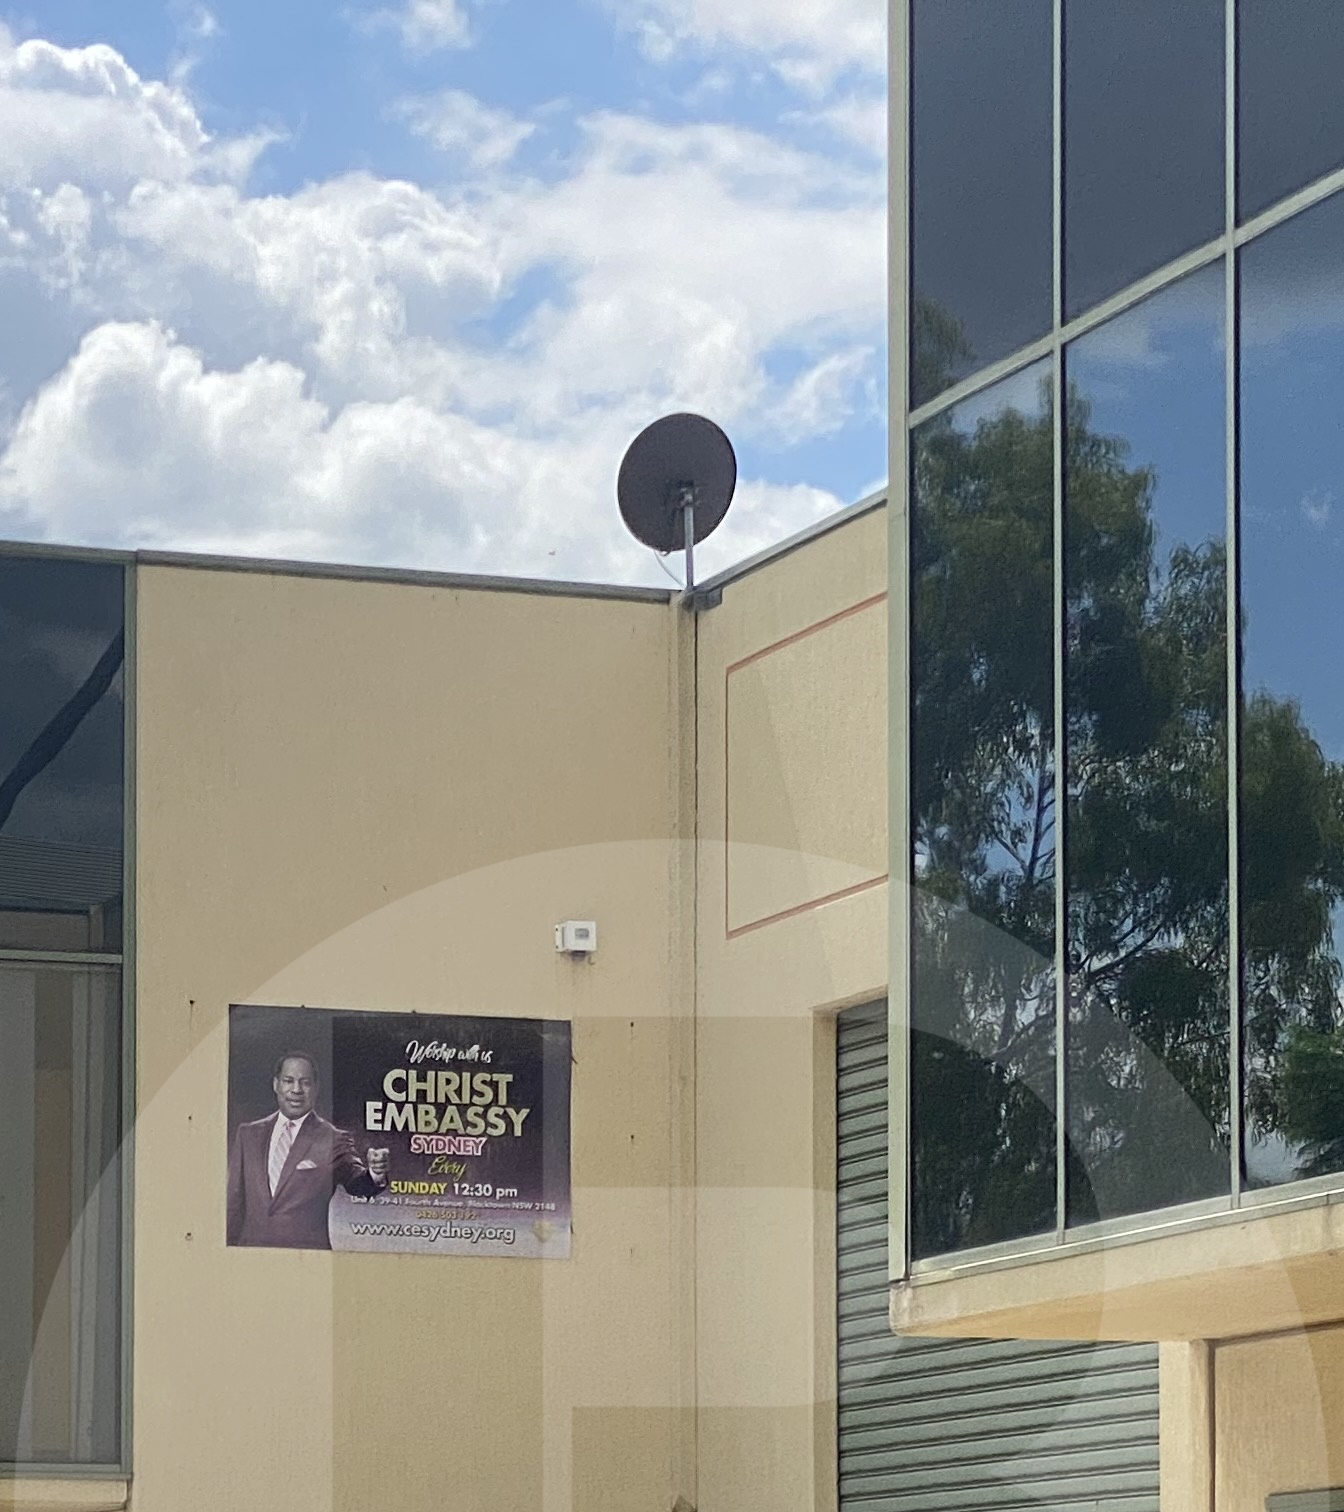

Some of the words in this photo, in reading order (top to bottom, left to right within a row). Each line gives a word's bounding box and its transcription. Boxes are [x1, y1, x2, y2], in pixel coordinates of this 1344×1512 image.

[406, 1040, 457, 1063] Worship
[382, 1068, 514, 1106] CHRIST
[365, 1101, 530, 1137] EMBASSY
[410, 1134, 487, 1156] SYDNEY
[427, 1155, 467, 1182] Every
[390, 1181, 447, 1195] SUNDAY
[453, 1183, 492, 1197] 12:30
[495, 1187, 518, 1200] pm
[511, 1202, 534, 1211] NSW
[351, 1220, 516, 1244] www.cesydney.org
